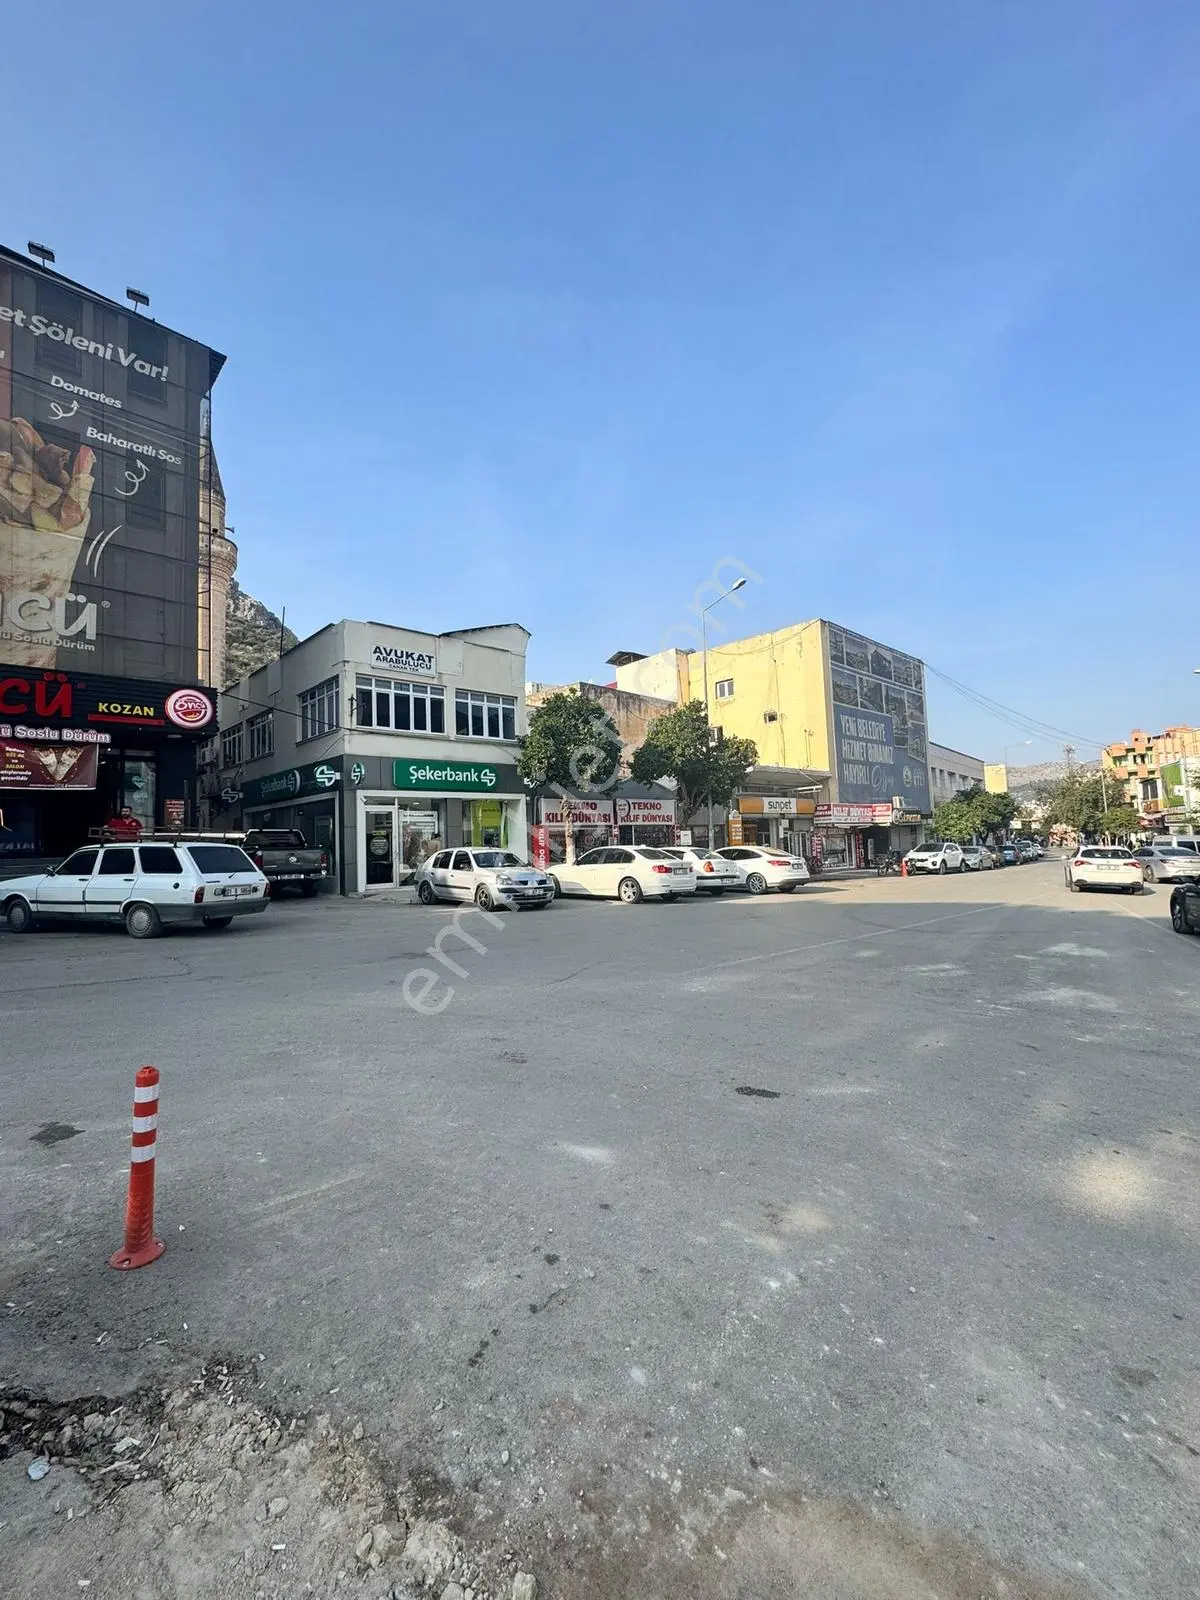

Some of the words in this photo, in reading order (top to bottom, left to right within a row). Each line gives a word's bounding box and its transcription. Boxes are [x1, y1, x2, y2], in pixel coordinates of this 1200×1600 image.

[29, 314, 113, 361] Şöleni
[117, 346, 169, 382] Var!
[50, 374, 122, 409] Domates
[86, 426, 156, 456] Baharatlı
[157, 449, 182, 465] Sos
[14, 631, 51, 646] Soslu
[54, 636, 96, 651] Dürüm
[372, 645, 435, 664] AVUKAT
[375, 654, 432, 670] ARABULUCU
[98, 702, 155, 716] KOZAN
[14, 724, 60, 740] Soslu
[61, 728, 111, 743] Dürüm
[841, 738, 867, 761] HİZMET
[409, 765, 478, 783] Şekerbank
[631, 801, 662, 811] TEKNO
[767, 800, 792, 812] sunpet
[571, 810, 611, 823] DÜNYASI
[620, 813, 640, 823] KILIF
[642, 811, 673, 823] DÜNYASI
